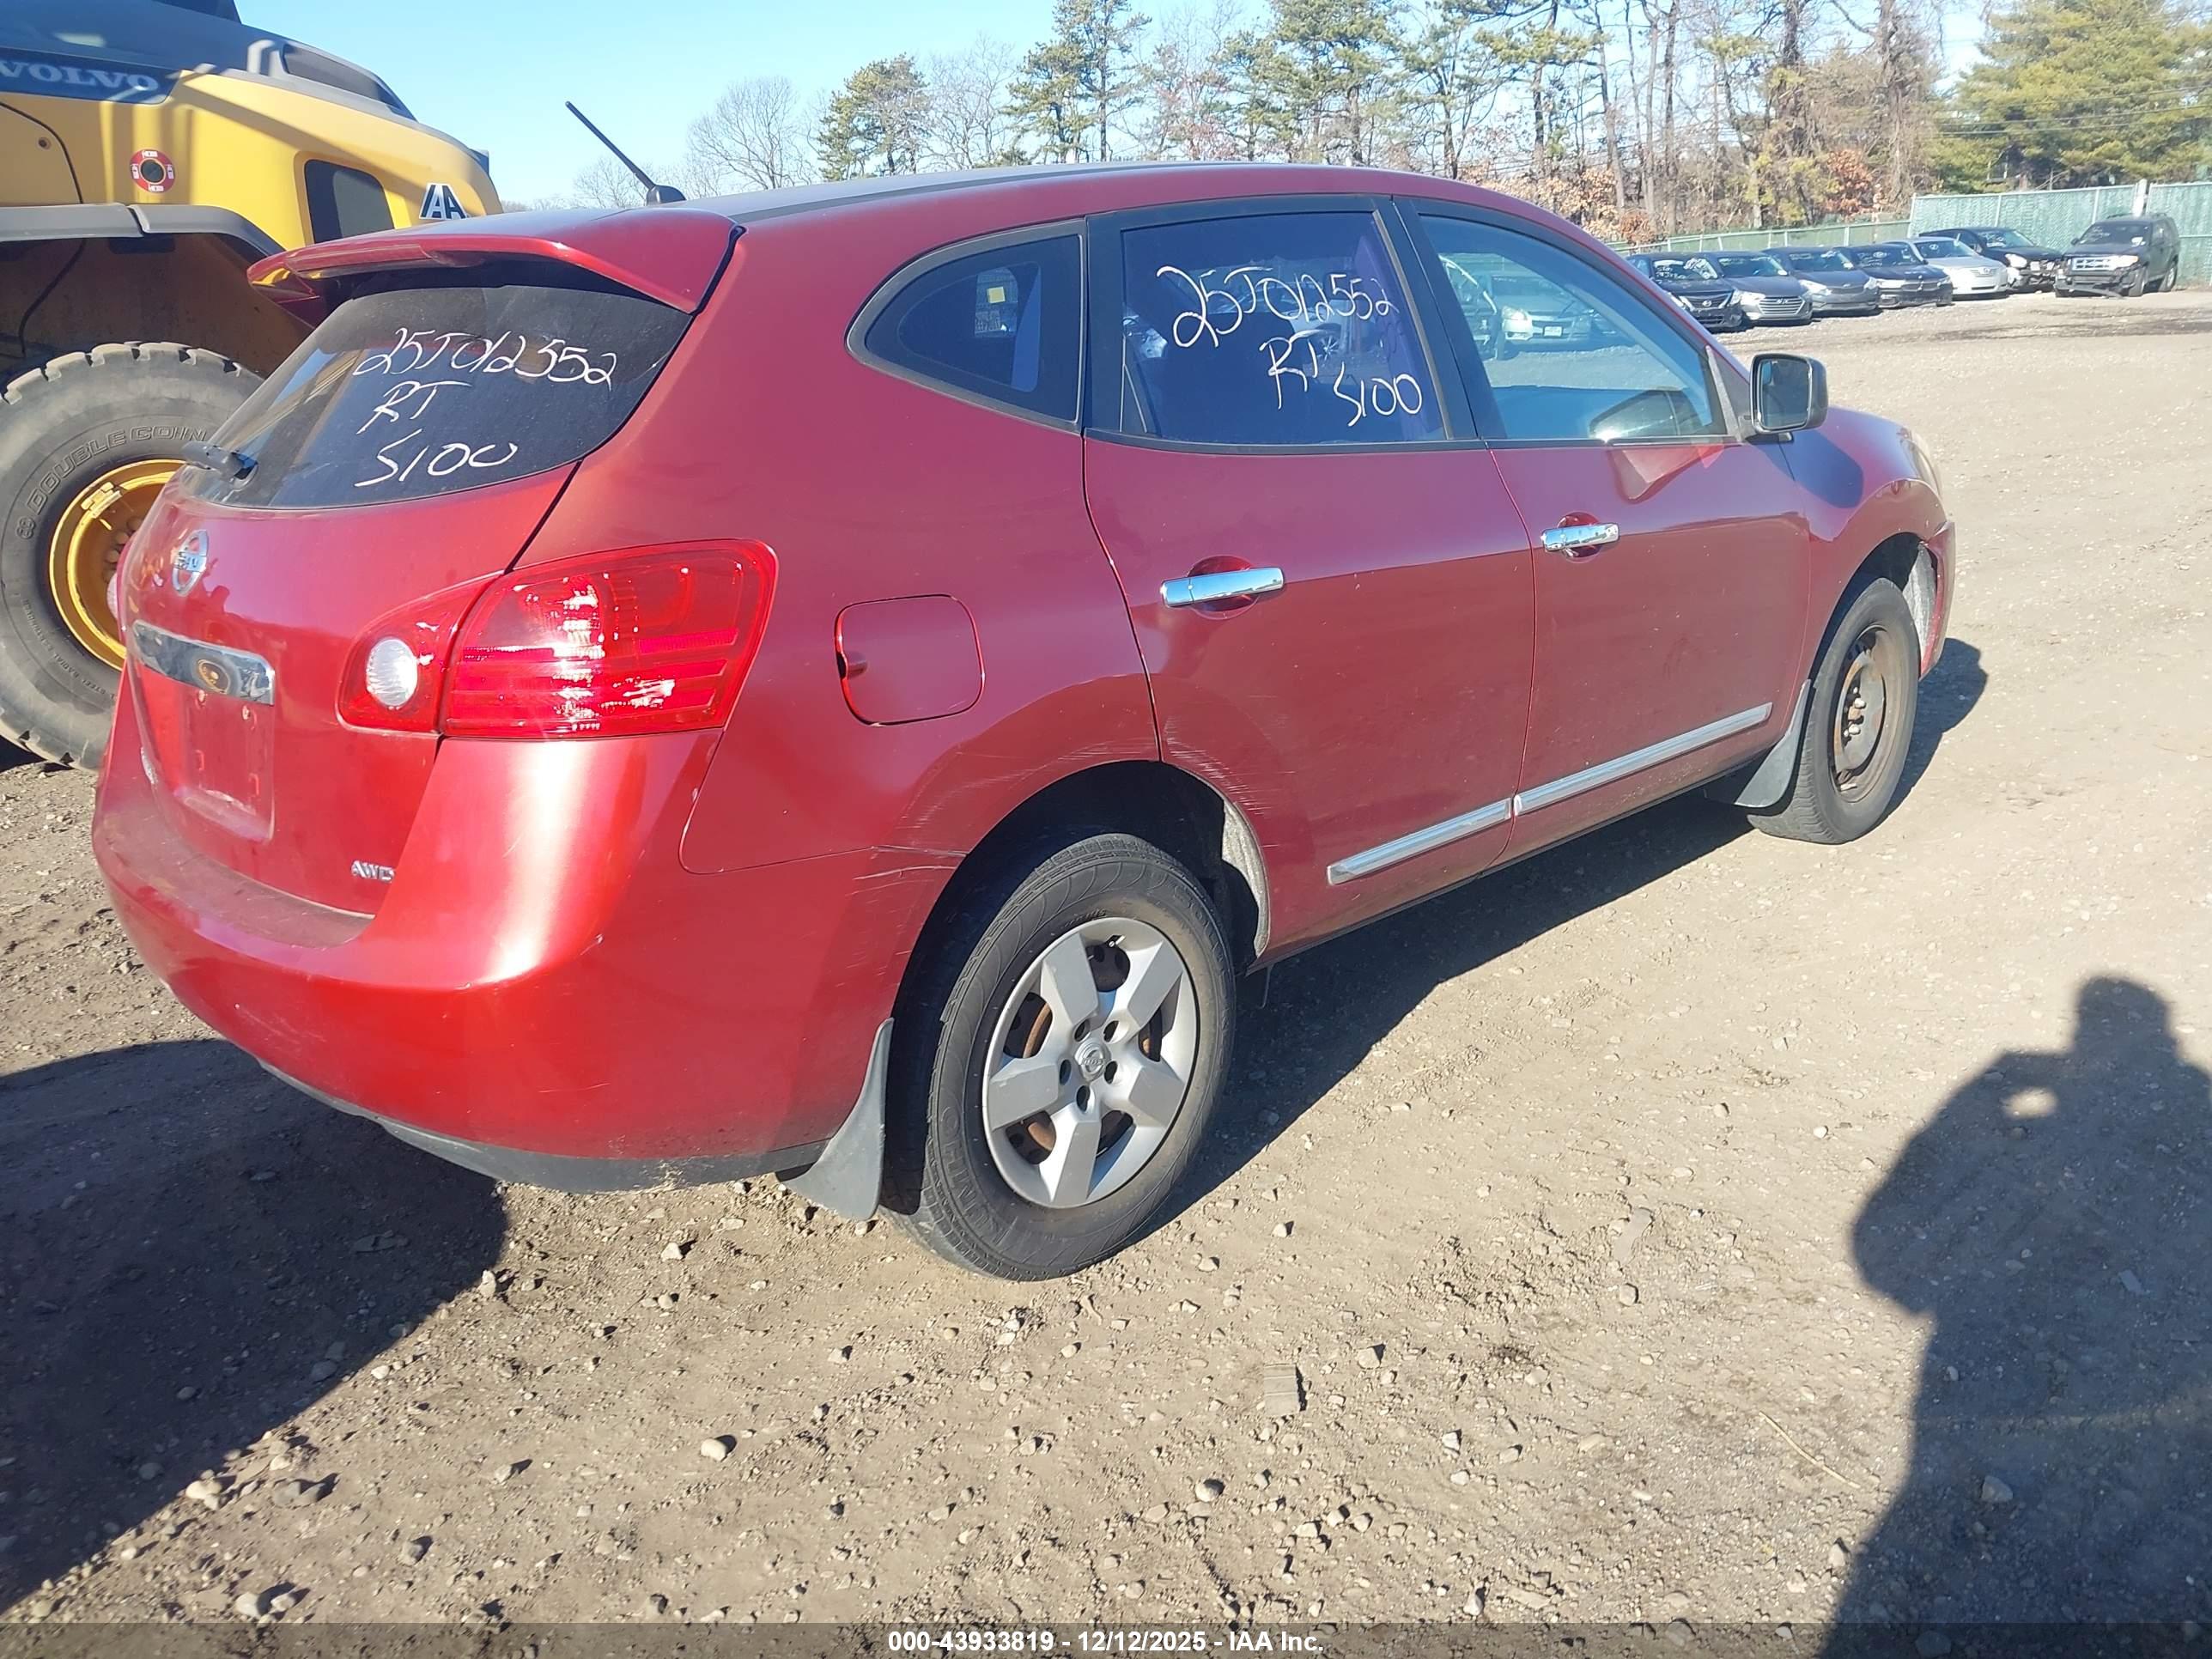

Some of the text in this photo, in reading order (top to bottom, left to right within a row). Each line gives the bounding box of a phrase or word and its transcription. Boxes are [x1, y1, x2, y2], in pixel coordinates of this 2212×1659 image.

[0, 60, 159, 91] VOLVO
[1259, 330, 1333, 410] RT
[356, 380, 472, 434] RT
[26, 426, 207, 514] DOUBLE COIN
[350, 860, 395, 882] AWD
